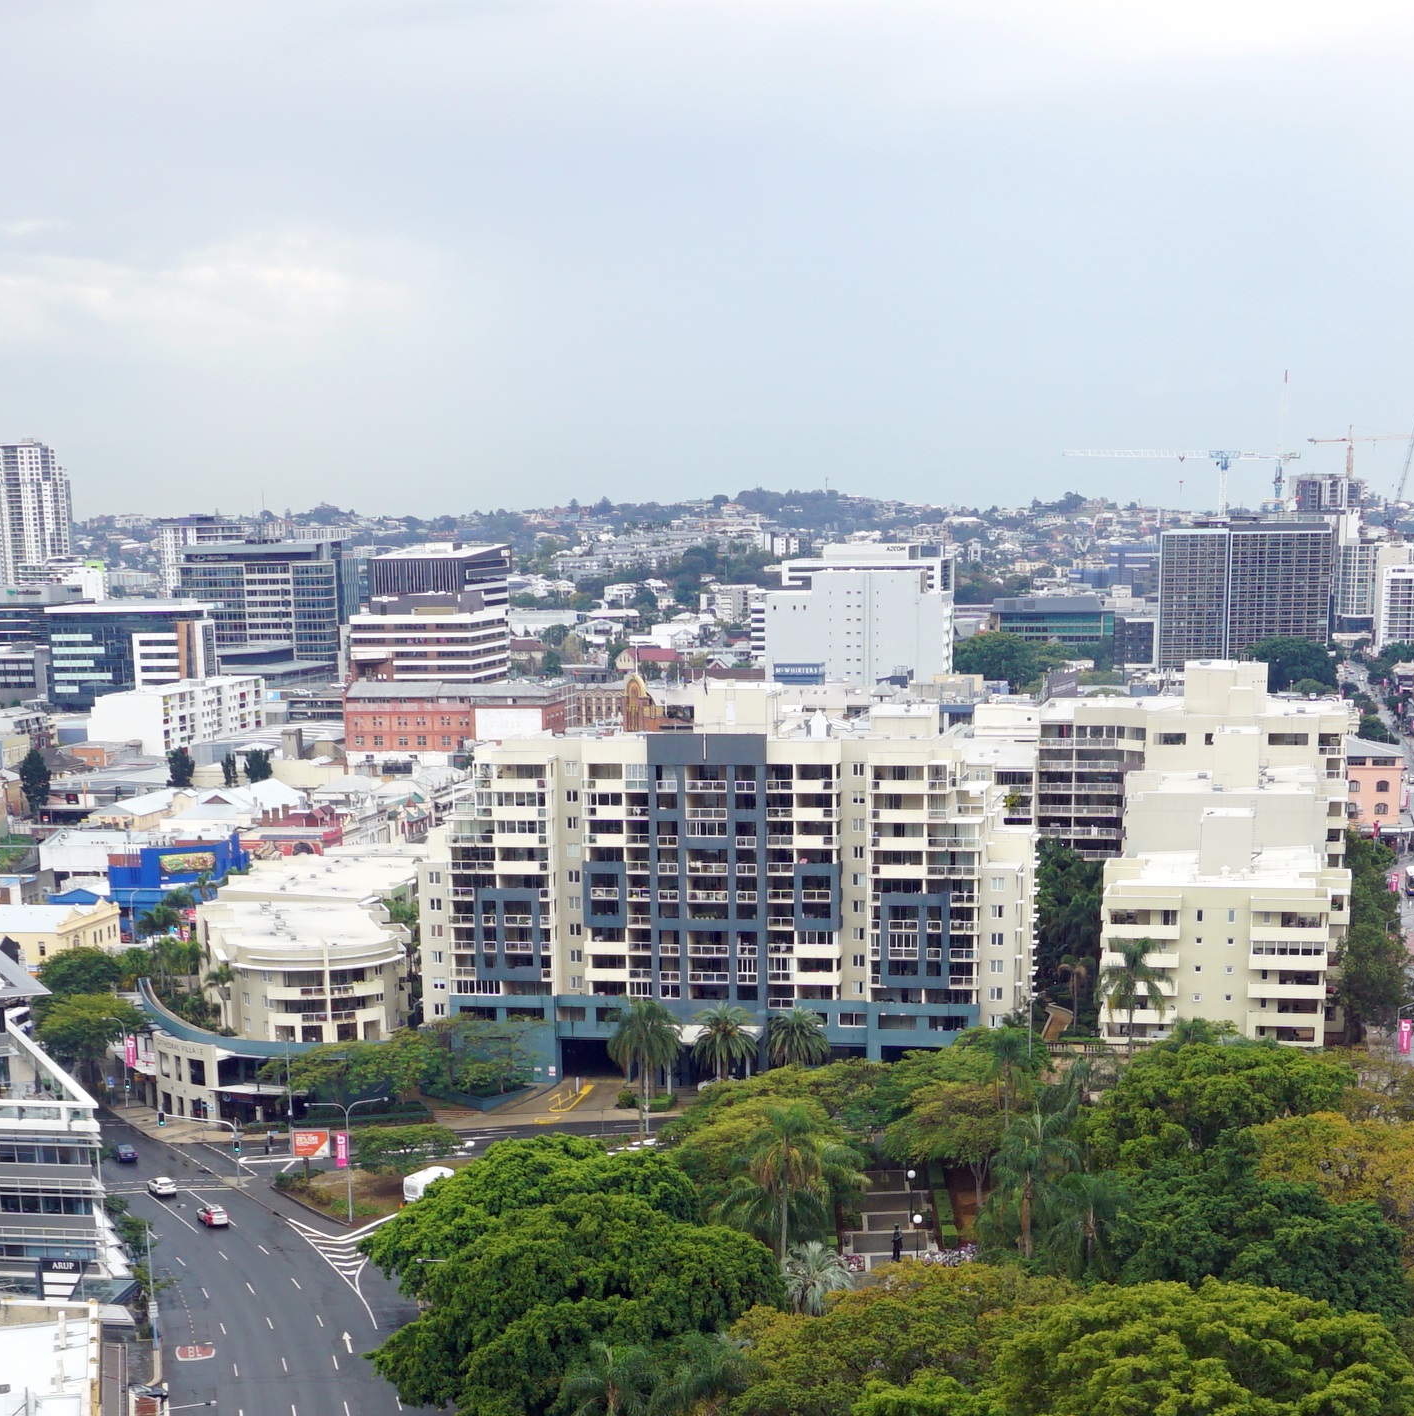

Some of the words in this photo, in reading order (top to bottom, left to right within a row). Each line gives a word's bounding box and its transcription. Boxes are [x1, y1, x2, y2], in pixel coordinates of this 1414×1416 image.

[182, 1046, 204, 1055] VILLAE
[51, 1262, 75, 1270] ARUP
[187, 1346, 203, 1358] BL
